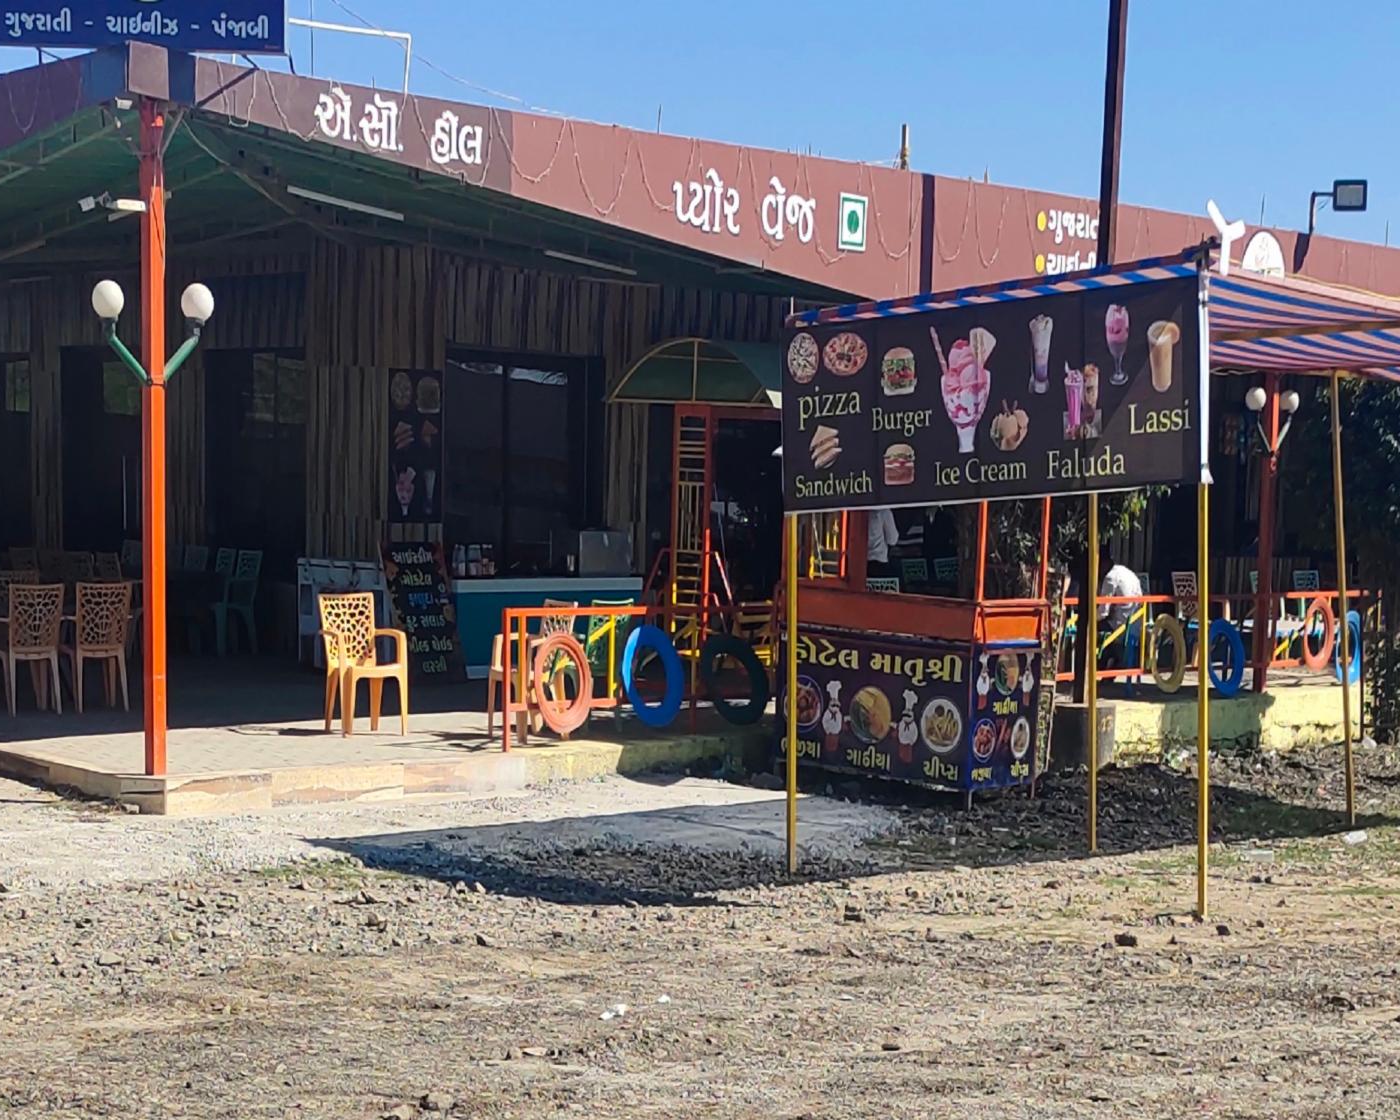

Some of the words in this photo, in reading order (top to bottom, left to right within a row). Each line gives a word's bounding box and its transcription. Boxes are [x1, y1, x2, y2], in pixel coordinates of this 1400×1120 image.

[4, 7, 72, 37] ગુજરાતી
[212, 12, 270, 40] પંજાબી
[672, 167, 741, 236] પ્યોર
[761, 175, 817, 244] વેજ
[1047, 208, 1100, 244] ગુજરાત
[798, 386, 862, 431] pizza
[871, 407, 933, 437] Burger
[1128, 399, 1192, 435] Lassi
[934, 460, 961, 486] Ice
[965, 457, 1028, 483] Cream
[1046, 445, 1126, 480] Faluda
[795, 470, 873, 498] Sandwich
[869, 653, 964, 687] માતૃશ્રી
